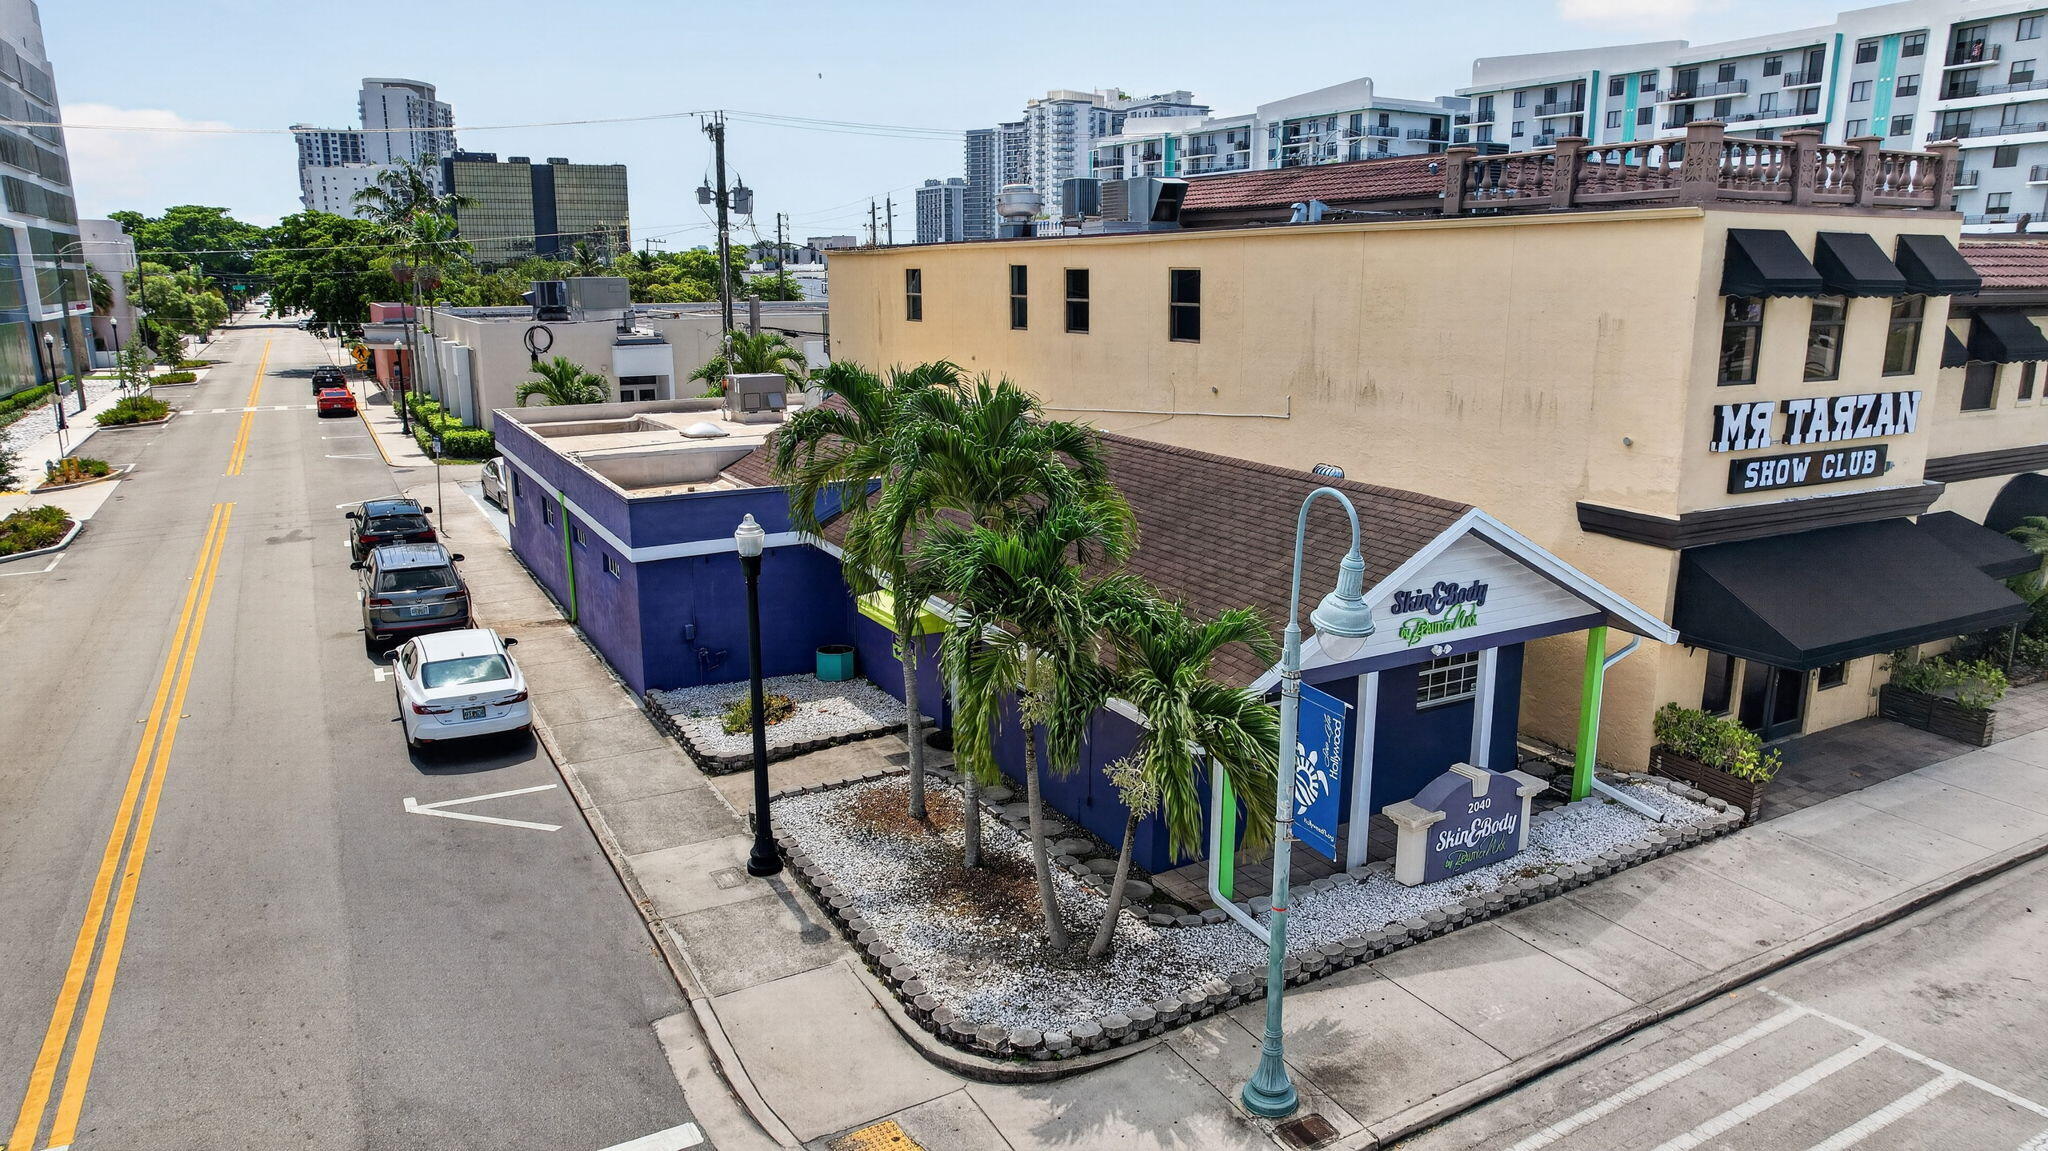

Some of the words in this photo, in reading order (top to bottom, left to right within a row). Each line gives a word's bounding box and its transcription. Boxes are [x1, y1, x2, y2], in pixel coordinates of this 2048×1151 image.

[1785, 391, 1922, 445] TARZAN
[1744, 456, 1812, 489] SHOW
[1821, 449, 1877, 479] CLUB
[1329, 717, 1342, 780] Hollywood
[1468, 798, 1491, 813] 2040
